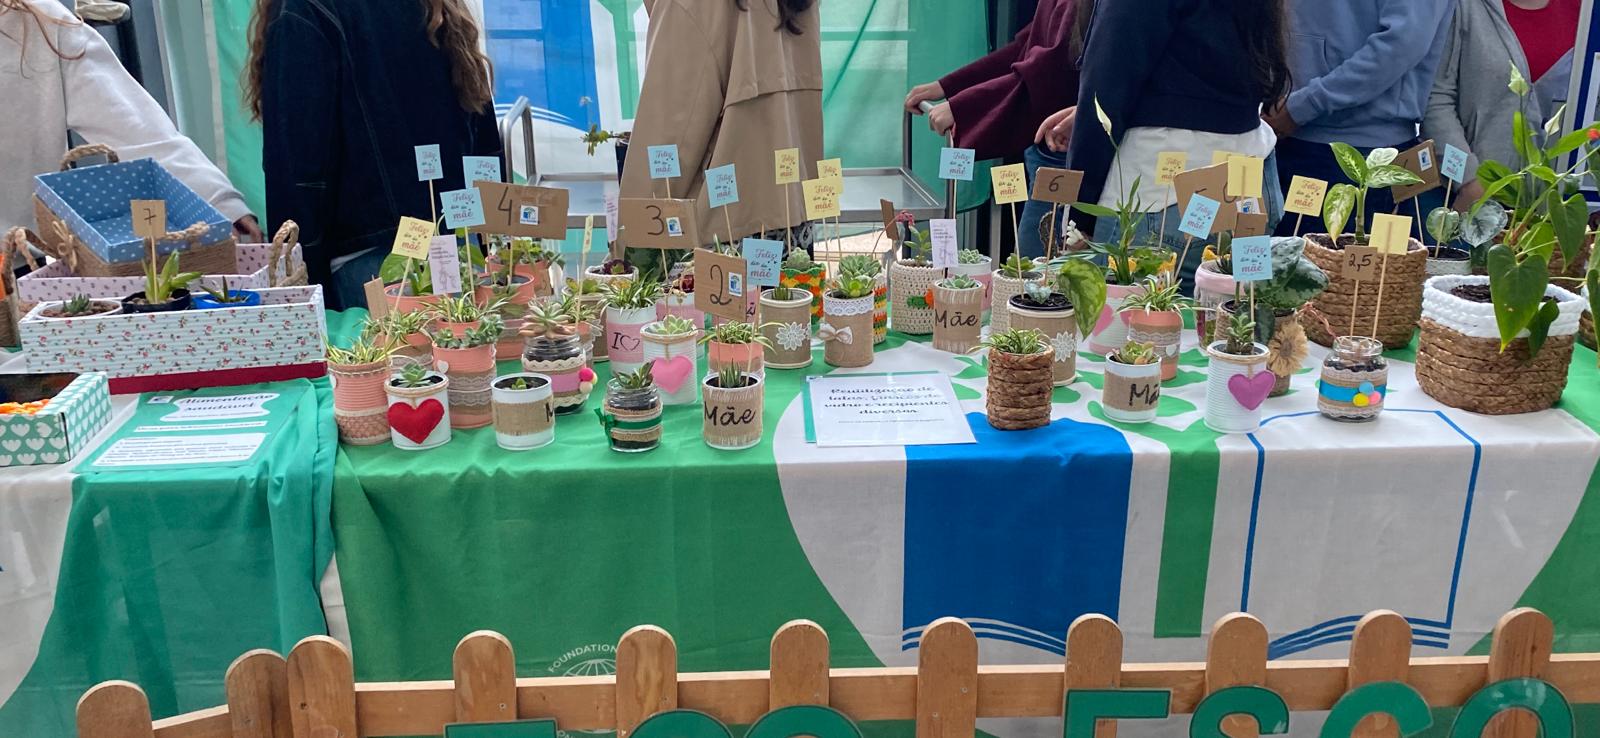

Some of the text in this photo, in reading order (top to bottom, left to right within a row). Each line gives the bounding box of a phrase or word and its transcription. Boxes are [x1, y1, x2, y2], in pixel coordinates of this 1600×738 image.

[1000, 170, 1018, 179] Feliz
[815, 184, 835, 194] Feliz
[1049, 175, 1065, 193] 6
[1302, 180, 1322, 192] Feliz
[452, 193, 474, 203] Feliz
[1294, 198, 1314, 208] mãe
[498, 186, 513, 226] 4
[144, 208, 157, 225] 7
[453, 211, 474, 220] mãe
[646, 205, 665, 236] 3
[409, 221, 430, 235] Feliz
[402, 242, 421, 251] mãe
[1243, 245, 1267, 255] Feliz
[755, 248, 778, 261] Feliz
[1241, 263, 1264, 273] mãe
[1349, 253, 1372, 272] 2,5
[751, 268, 772, 278] mãe
[710, 264, 732, 306] 2
[934, 309, 978, 329] Mãe
[704, 400, 756, 426] Mãe
[548, 643, 617, 673] FOUNDATION
